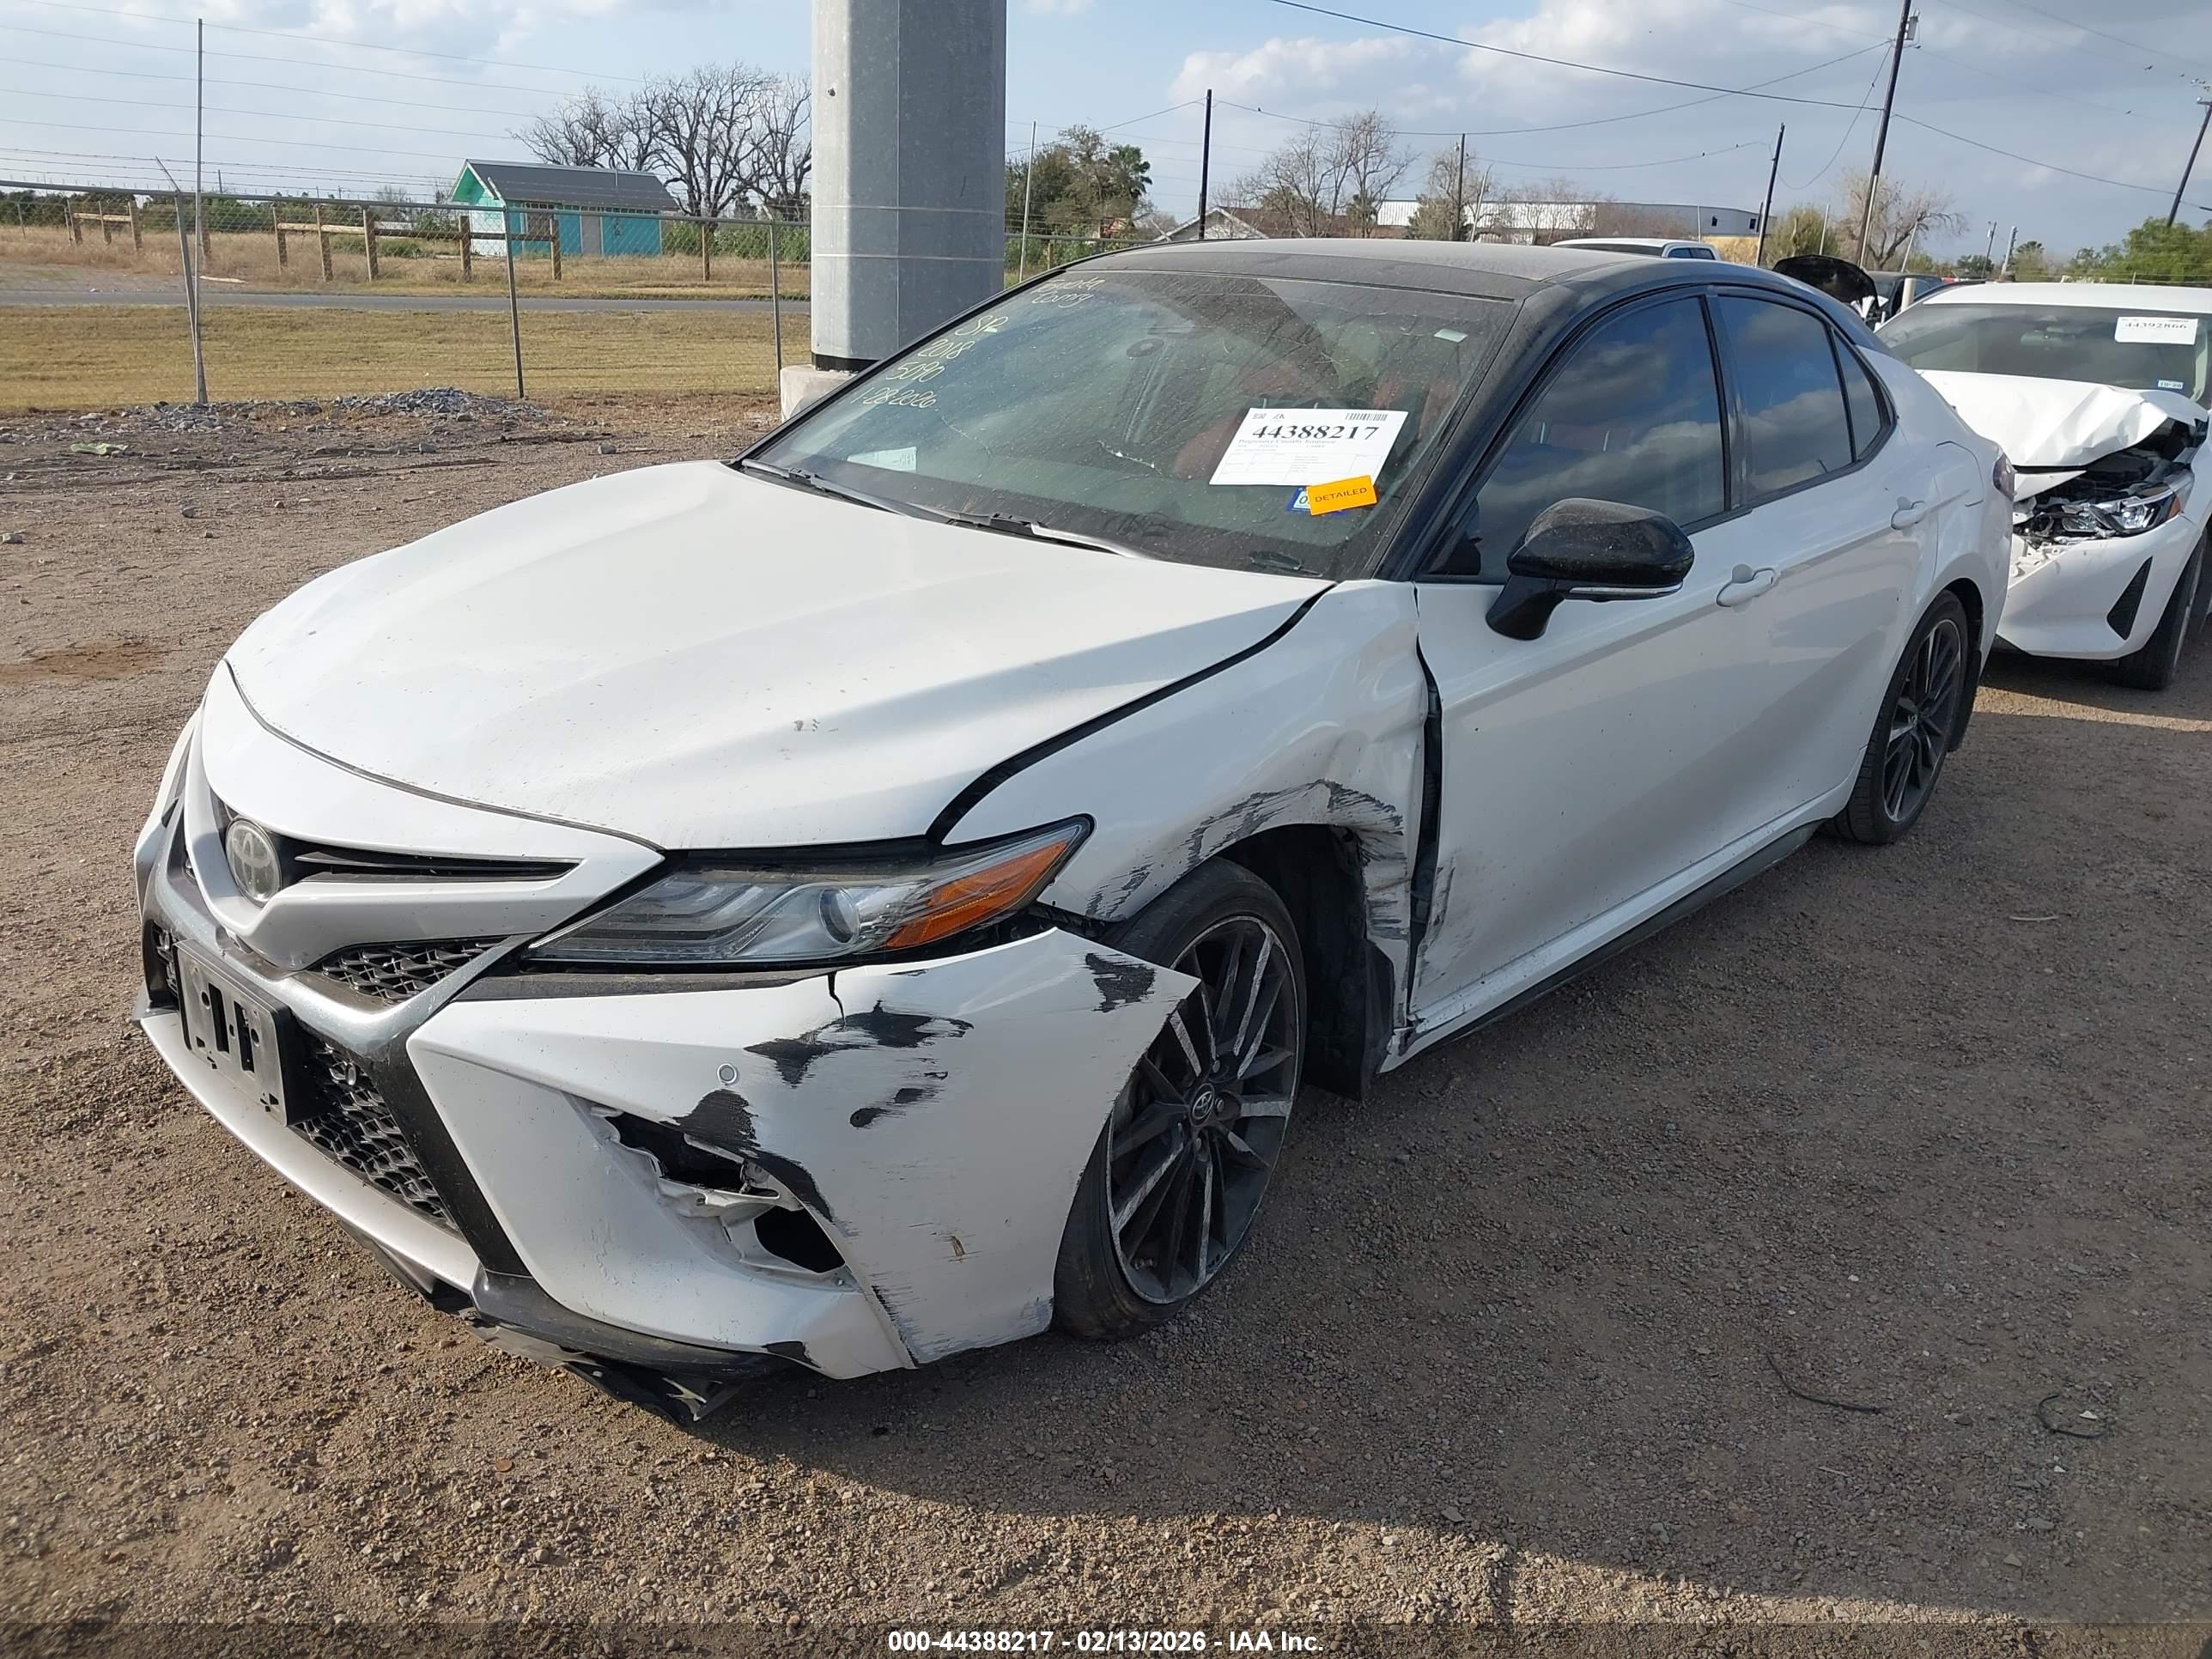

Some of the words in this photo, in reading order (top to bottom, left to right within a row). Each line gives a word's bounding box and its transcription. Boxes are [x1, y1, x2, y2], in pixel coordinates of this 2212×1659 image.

[917, 338, 975, 360] 2018
[1252, 424, 1380, 441] 44388217
[1315, 487, 1368, 502] DETAILED
